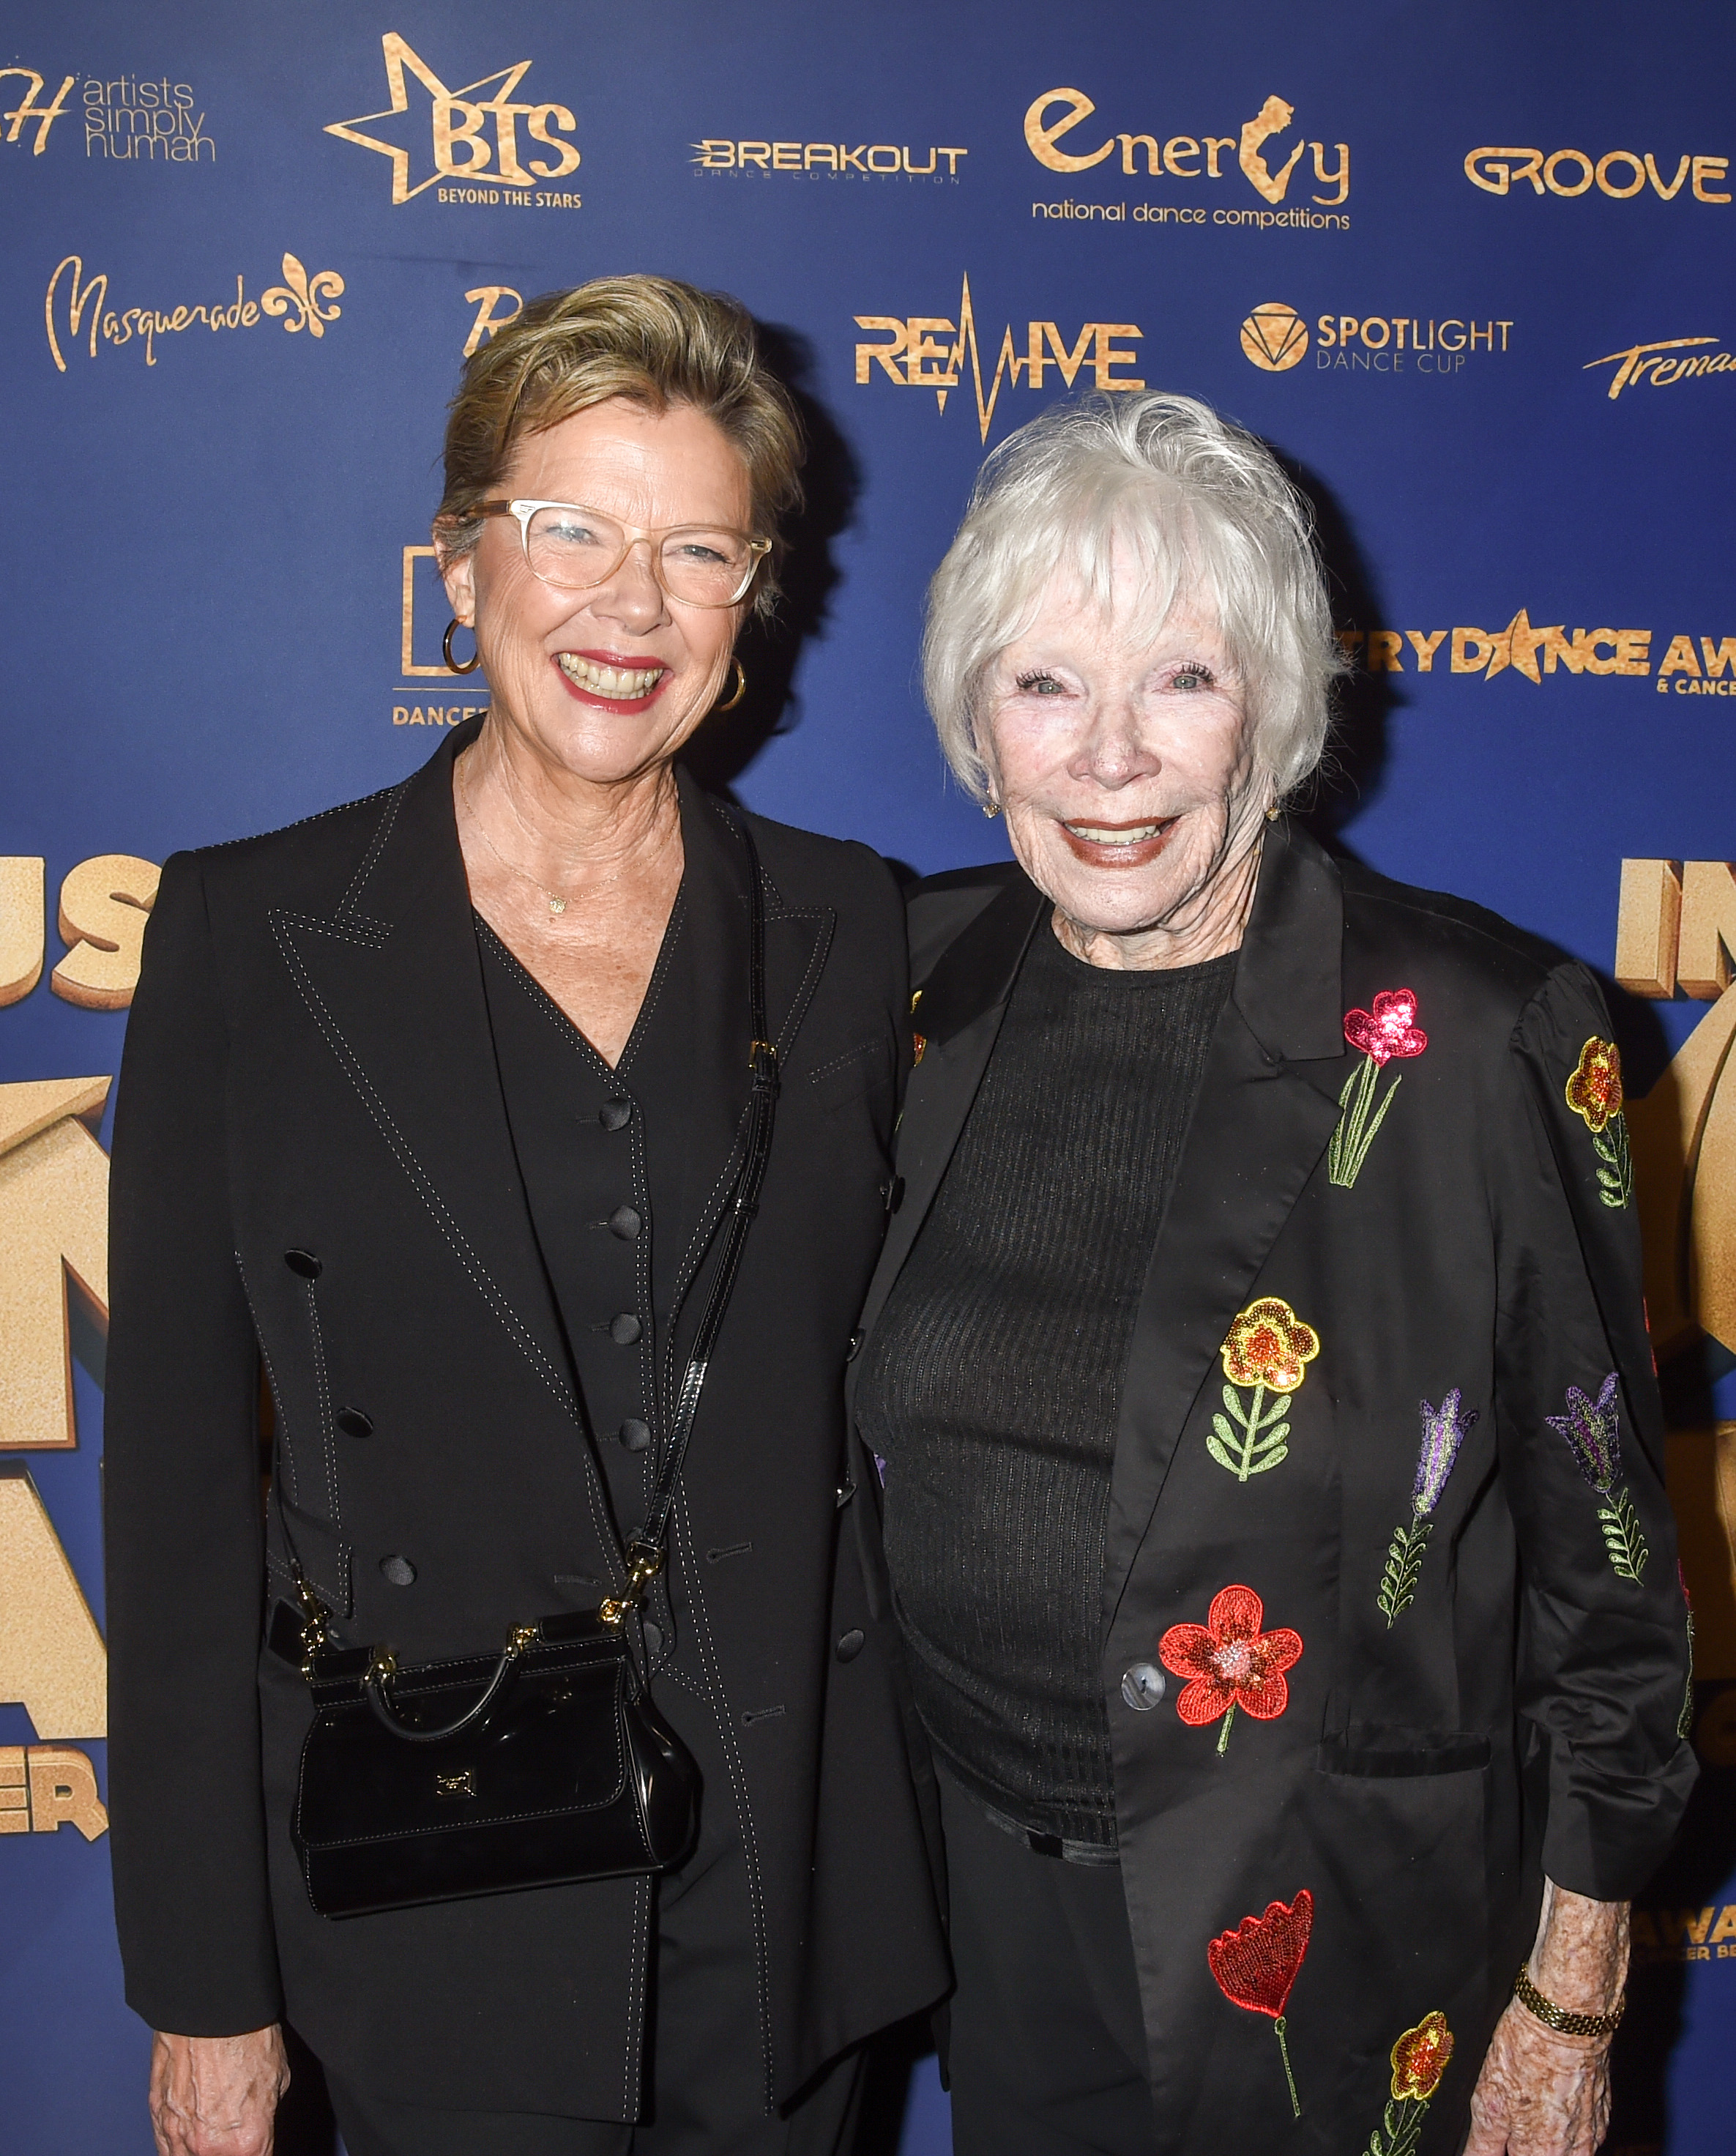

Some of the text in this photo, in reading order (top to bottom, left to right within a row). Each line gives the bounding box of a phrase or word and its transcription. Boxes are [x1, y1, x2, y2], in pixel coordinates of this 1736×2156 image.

[83, 74, 194, 110] artists
[85, 103, 205, 144] simply
[85, 122, 216, 162] human
[432, 99, 581, 187] BTS
[686, 139, 968, 175] BREAKOUT
[693, 169, 961, 185] DANCE COMPETITION
[1464, 146, 1732, 204] GROOVE
[438, 187, 582, 209] BEYOND THE STARS
[1032, 198, 1350, 230] national dance competitions
[45, 255, 261, 373] Masquerade
[1317, 315, 1514, 352] SPOTLIGHT
[1317, 351, 1466, 373] DANCE CUP
[1657, 634, 1736, 677] AW
[1656, 677, 1669, 694] &
